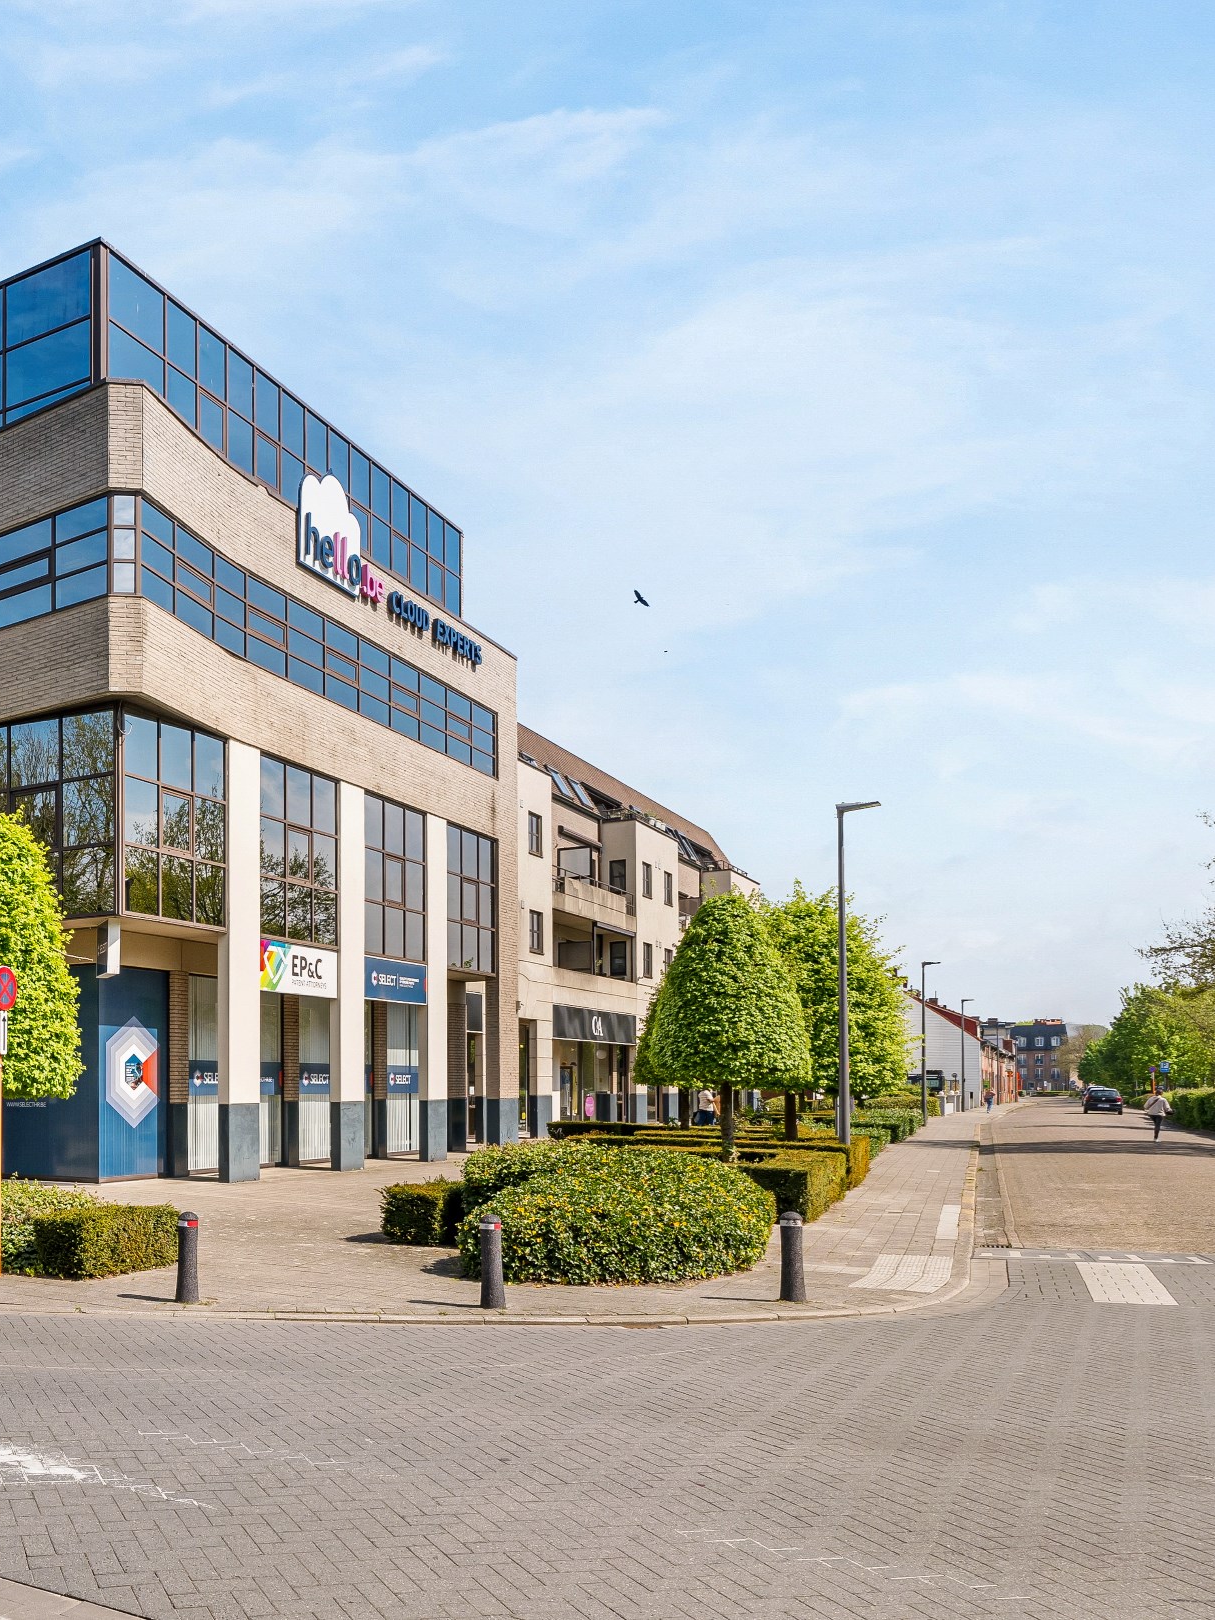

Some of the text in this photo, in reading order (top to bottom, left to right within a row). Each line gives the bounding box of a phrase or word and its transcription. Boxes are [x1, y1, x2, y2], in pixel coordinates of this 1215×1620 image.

[304, 512, 482, 666] hello.be CLOUD EXPERTS
[292, 955, 323, 979] EP&C
[292, 979, 327, 989] PATENT ATTORNEYS
[378, 974, 397, 986] SELECT
[203, 1073, 218, 1084] SELE
[310, 1073, 329, 1085] SELECT
[395, 1074, 411, 1085] SELECT
